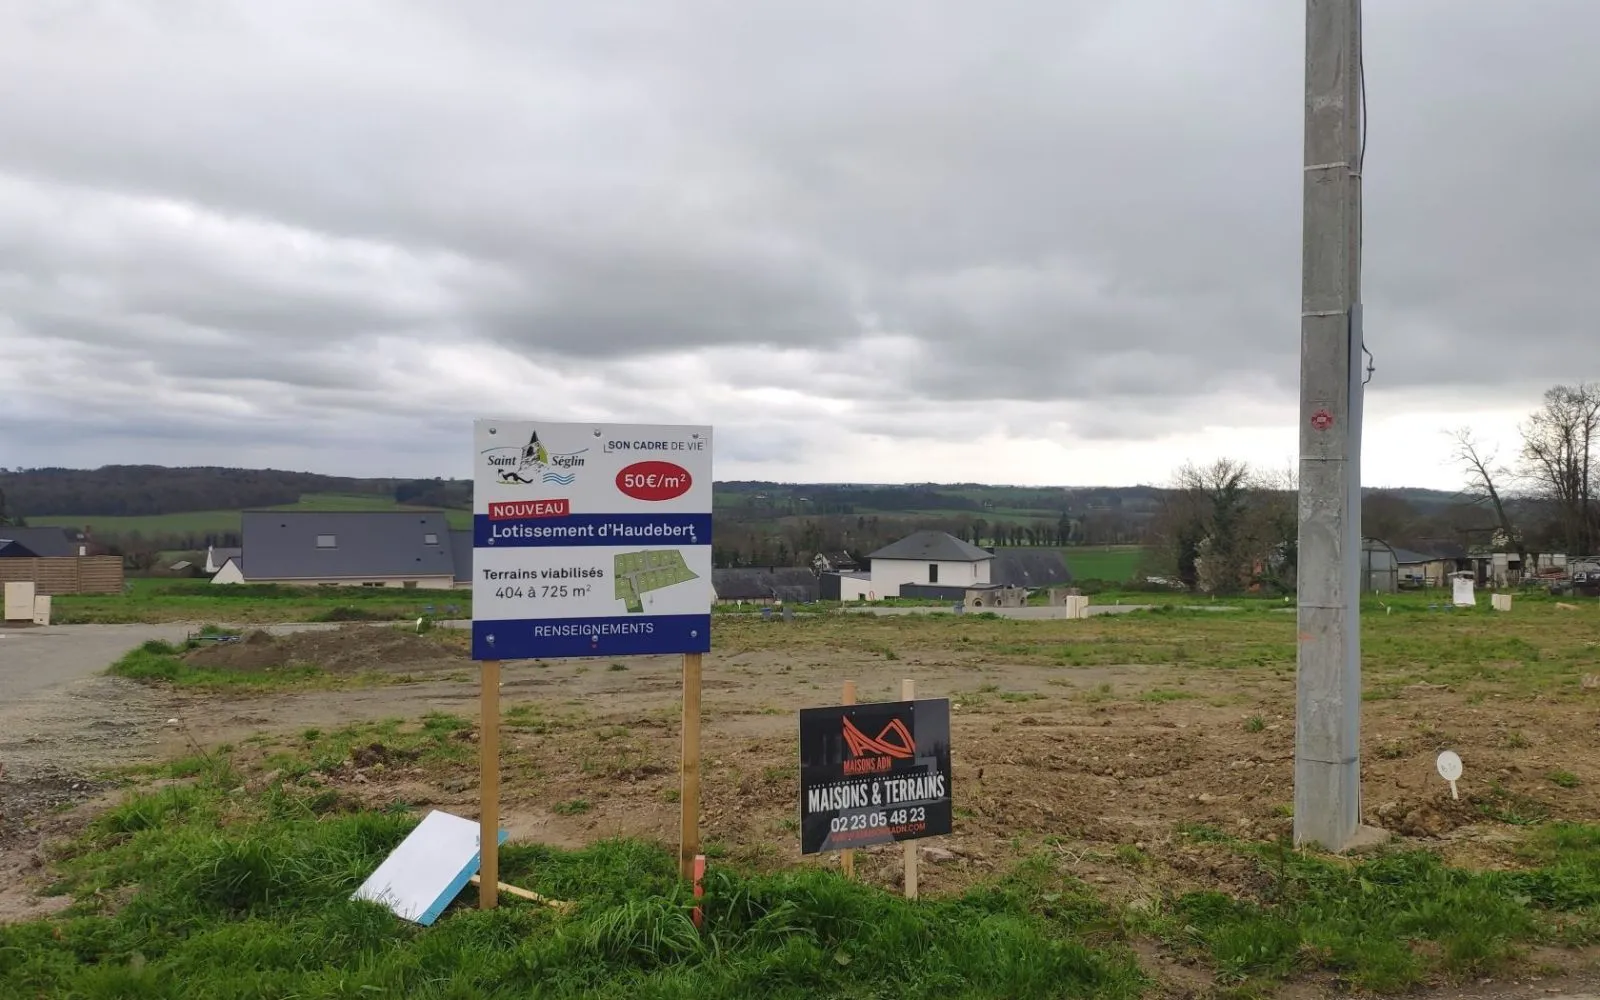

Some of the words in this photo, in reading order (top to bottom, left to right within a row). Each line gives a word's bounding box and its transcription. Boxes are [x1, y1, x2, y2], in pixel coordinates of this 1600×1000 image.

[608, 440, 631, 450] SON
[633, 441, 669, 450] CADRE
[671, 441, 685, 450] DE
[687, 441, 704, 451] VIE
[487, 455, 517, 466] Saint
[551, 454, 585, 469] Séglin
[624, 473, 686, 489] 50€/m²
[493, 502, 564, 517] NOUVEAU
[492, 524, 594, 538] Lotissement
[597, 523, 695, 537] d'Haudebert
[483, 568, 537, 580] Terrains
[541, 567, 604, 579] viabilisés
[495, 587, 523, 599] 404
[527, 585, 537, 598] à
[541, 586, 568, 598] 725
[534, 622, 654, 637] RENSEIGNEMENTS
[843, 758, 876, 772] MAISONS
[808, 782, 868, 813] MAISONS
[872, 781, 882, 805] &
[884, 775, 945, 804] TERRAINS
[831, 816, 848, 832] 02
[851, 814, 867, 829] 23
[869, 811, 887, 828] 05
[890, 809, 907, 824] 48
[910, 807, 926, 822] 23
